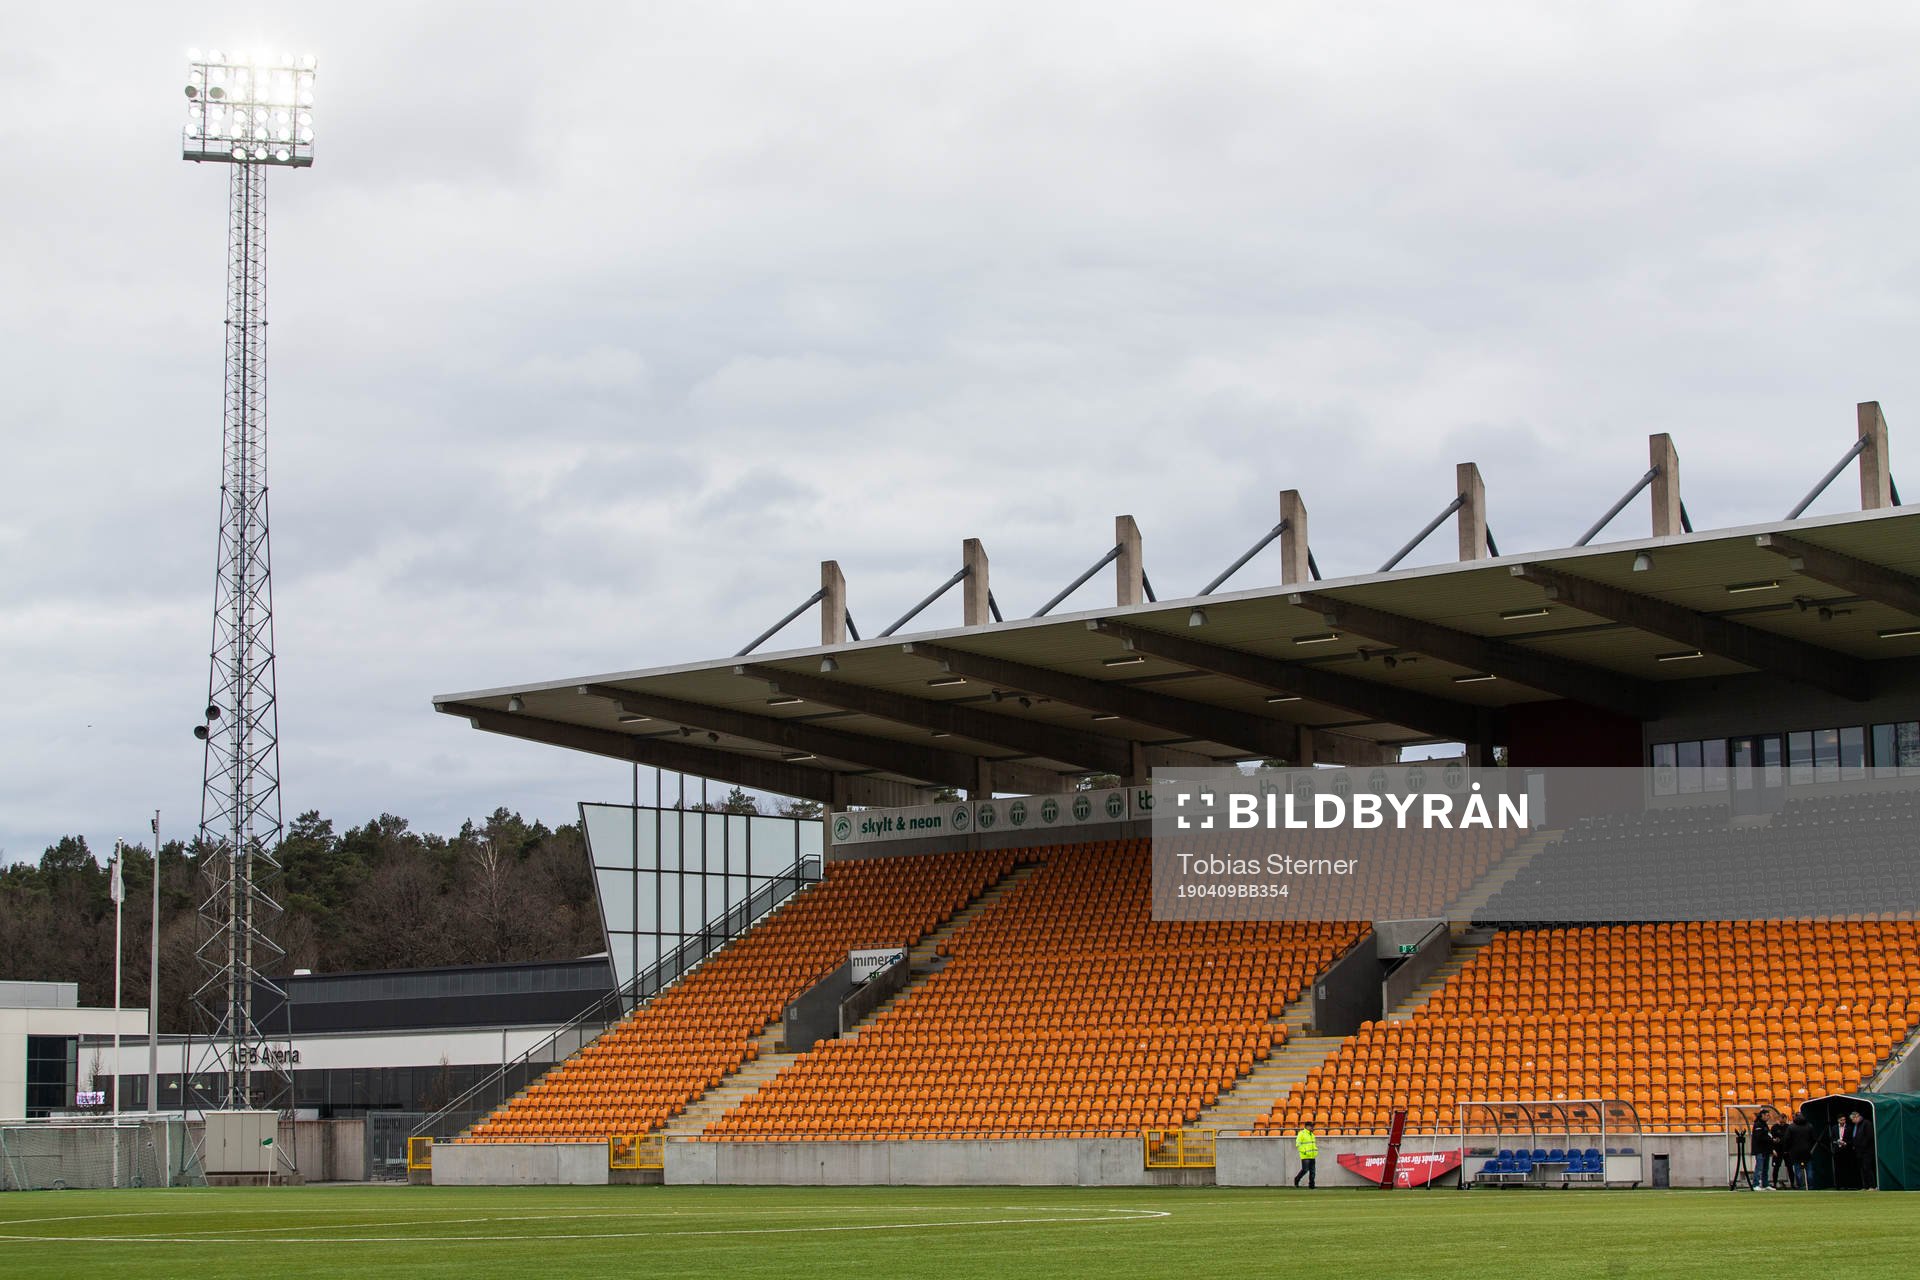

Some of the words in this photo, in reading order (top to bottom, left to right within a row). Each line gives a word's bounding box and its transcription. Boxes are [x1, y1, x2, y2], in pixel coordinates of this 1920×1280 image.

[861, 817, 892, 836] skylt
[896, 817, 905, 830] &
[910, 816, 942, 830] neon
[262, 1047, 299, 1064] Arena
